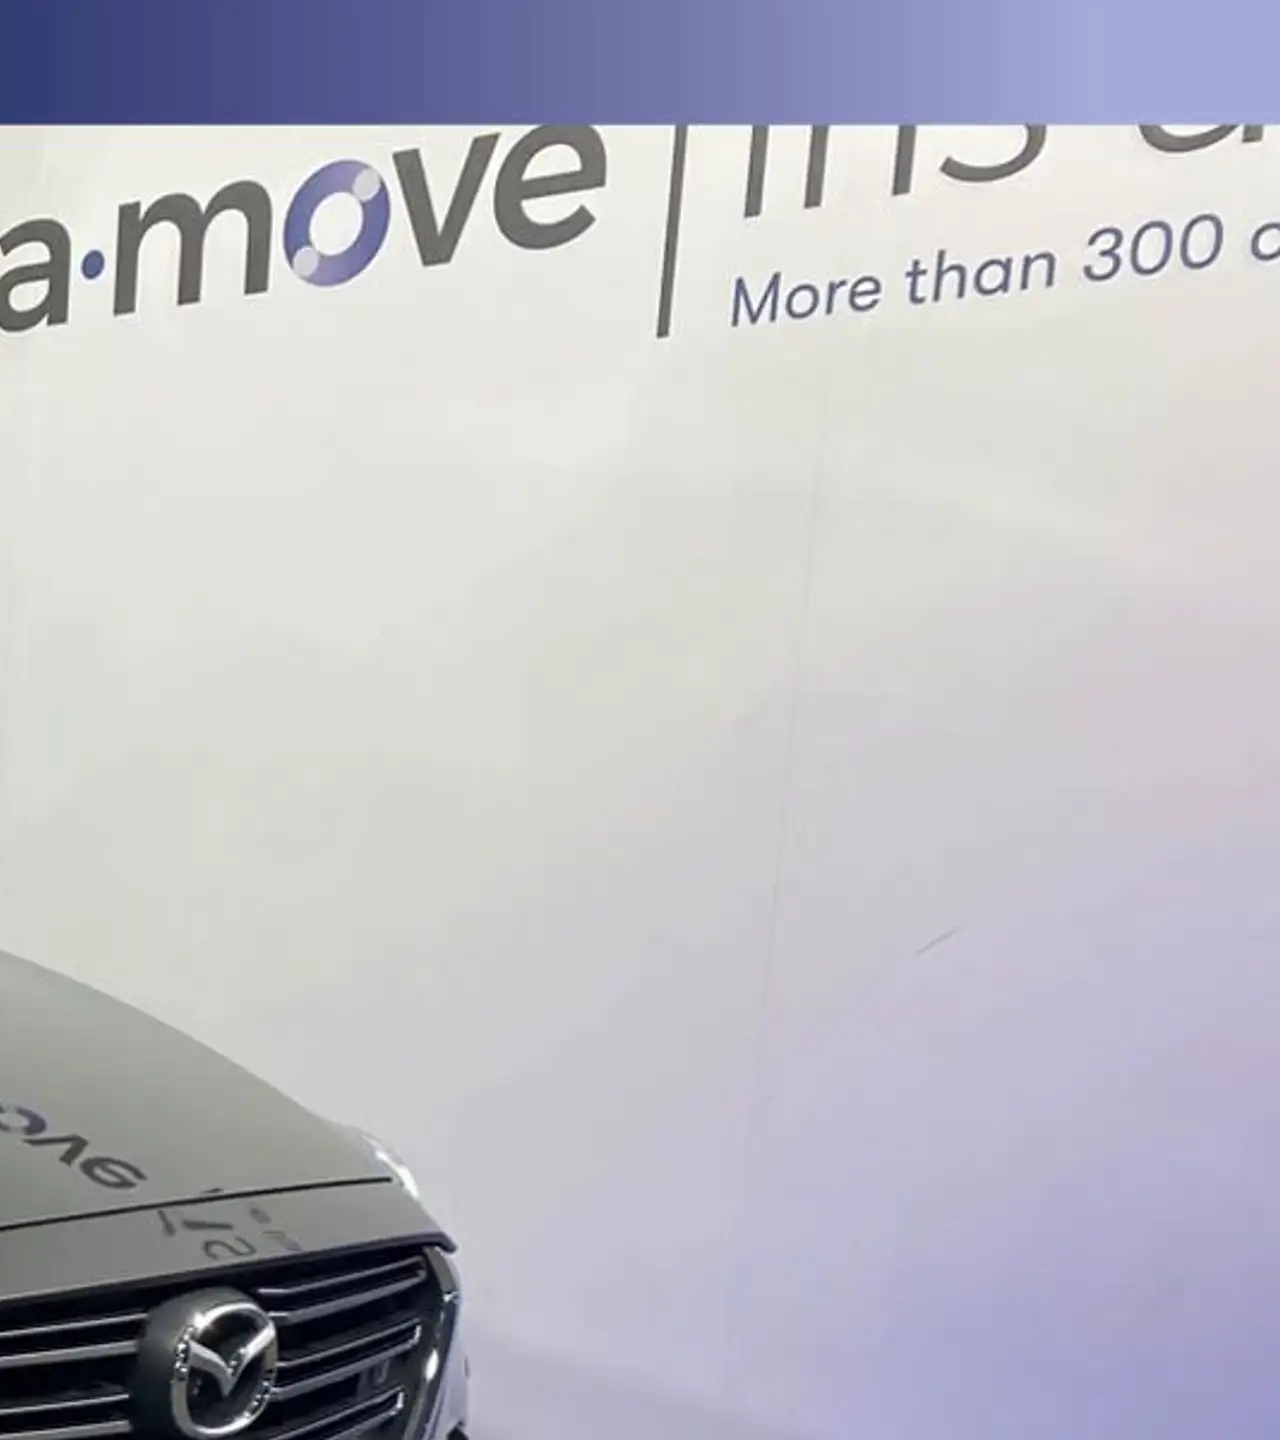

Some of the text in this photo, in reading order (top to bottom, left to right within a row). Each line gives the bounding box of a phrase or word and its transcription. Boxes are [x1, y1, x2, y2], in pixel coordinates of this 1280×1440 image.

[732, 272, 882, 327] More
[906, 250, 1056, 304] than
[1083, 213, 1224, 281] 300
